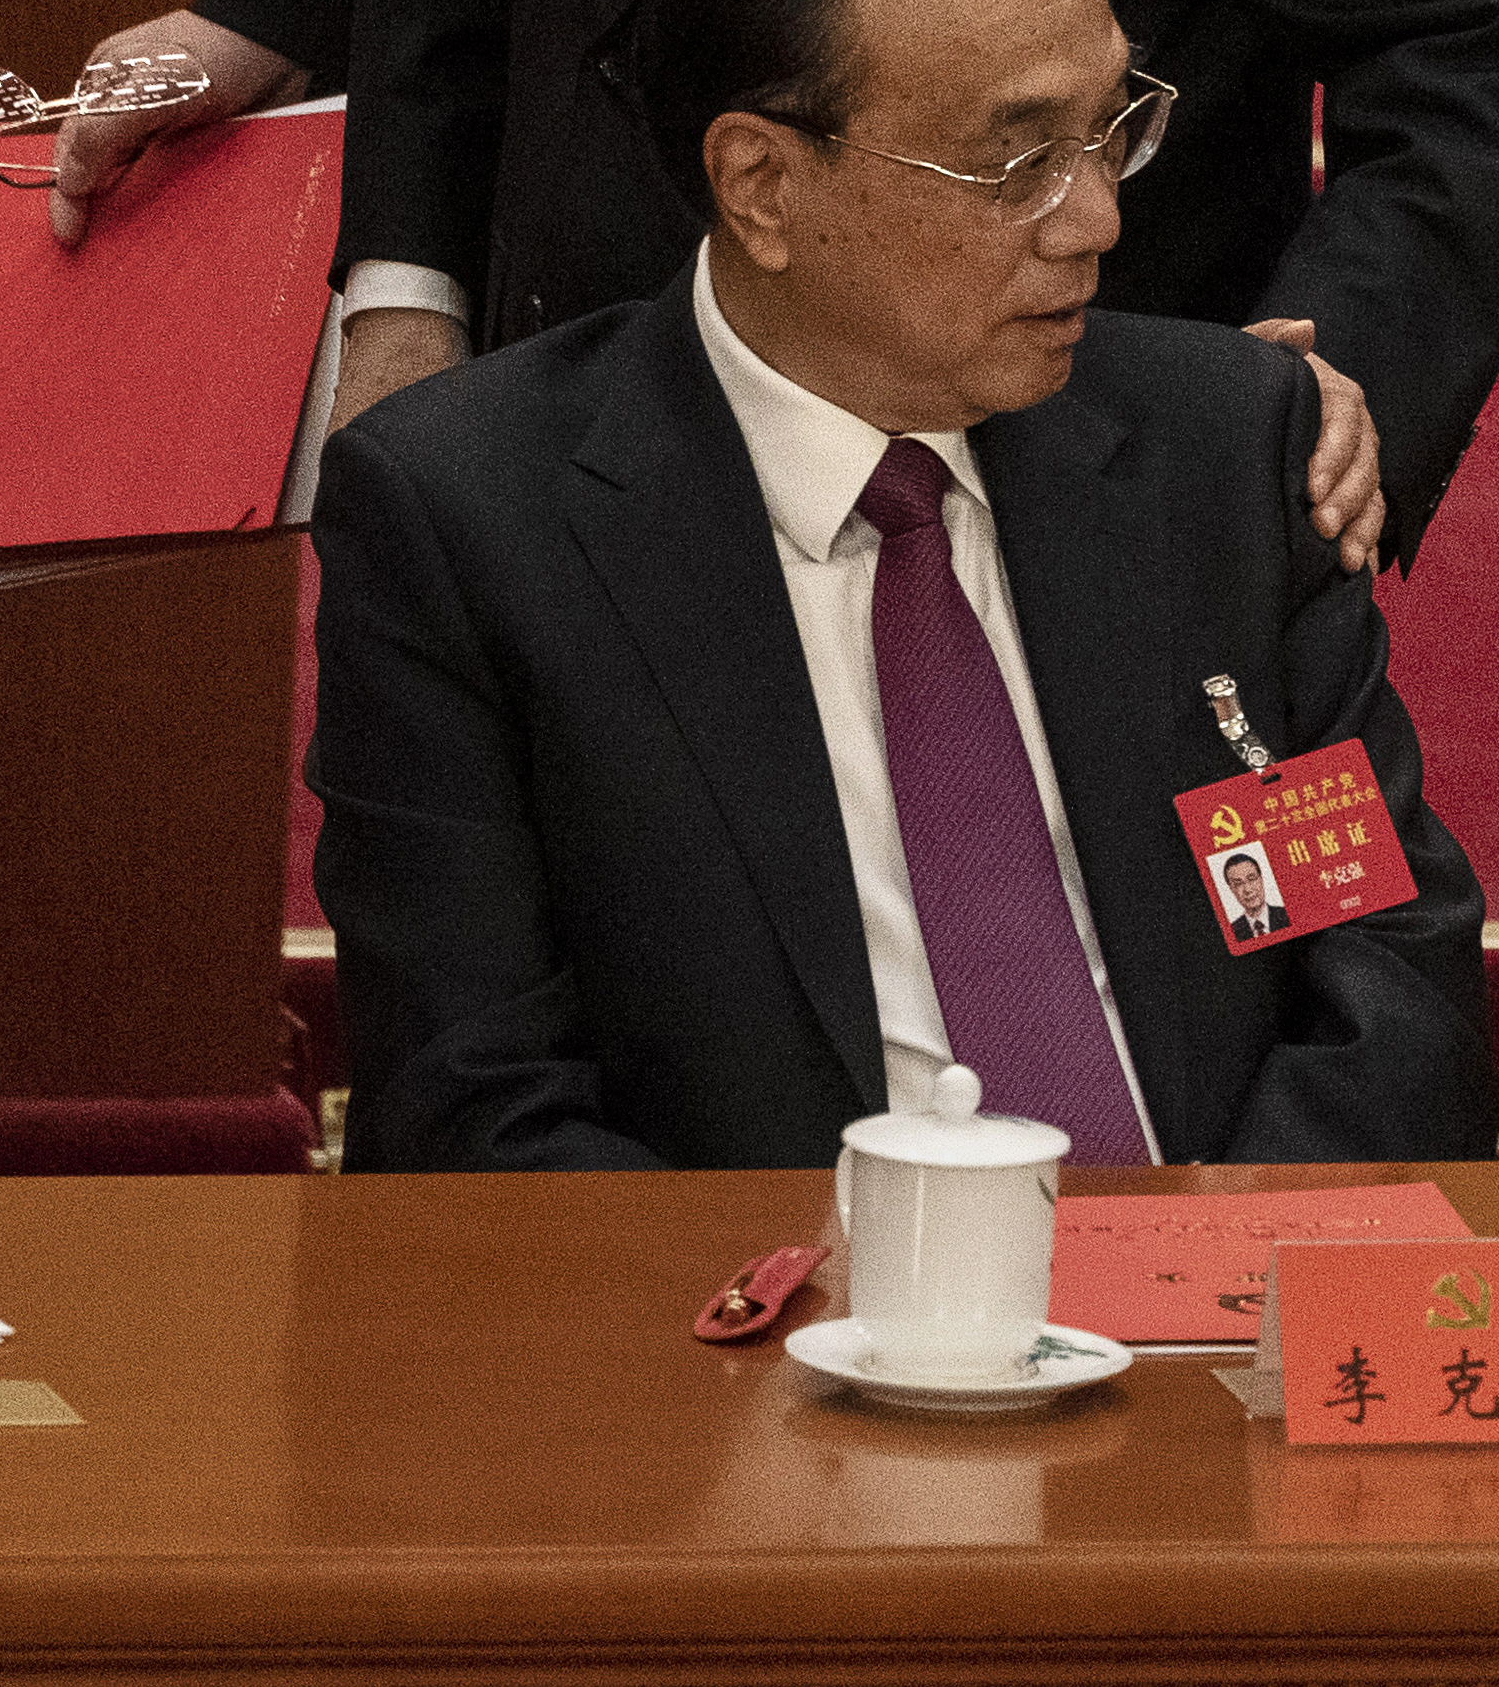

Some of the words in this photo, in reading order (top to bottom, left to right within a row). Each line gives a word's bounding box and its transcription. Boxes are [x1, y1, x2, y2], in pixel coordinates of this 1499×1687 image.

[1262, 771, 1357, 813] 中国共产党
[1286, 819, 1372, 867] 出席证
